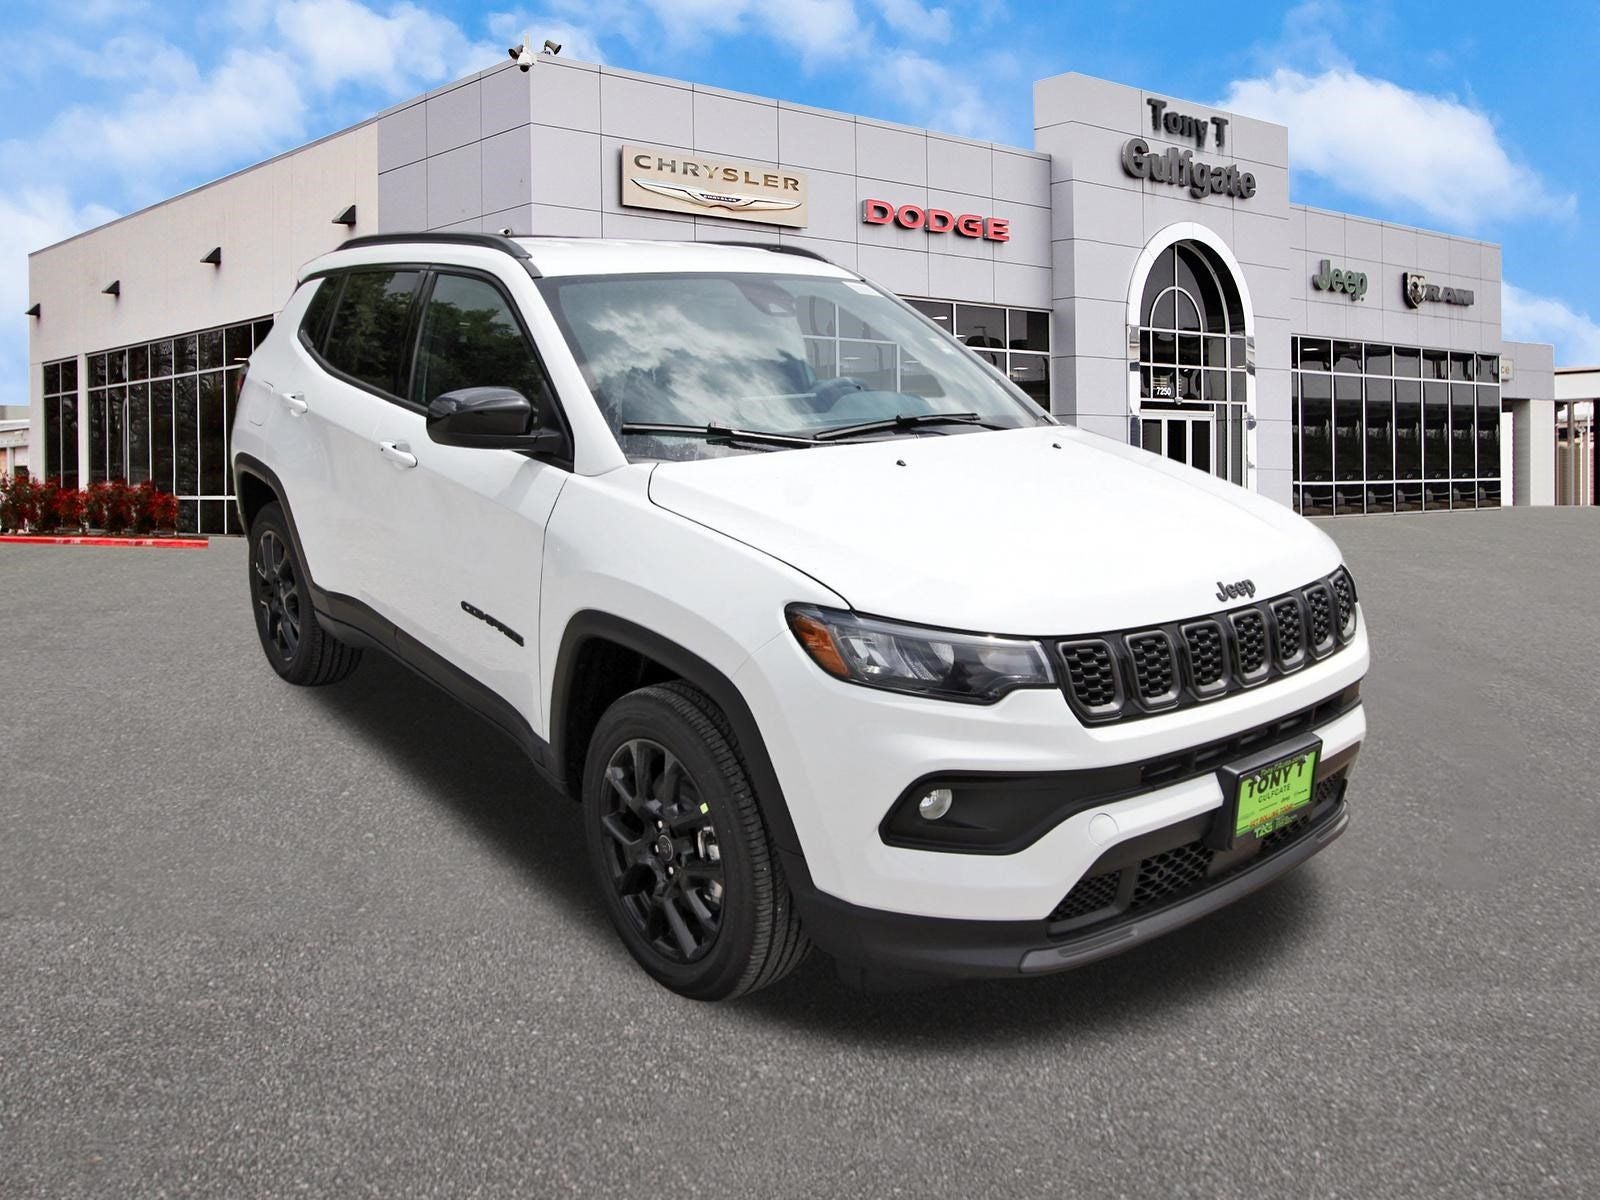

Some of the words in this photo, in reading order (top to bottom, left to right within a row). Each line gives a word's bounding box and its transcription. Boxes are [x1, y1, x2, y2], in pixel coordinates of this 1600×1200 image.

[1146, 98, 1208, 148] Tony
[1210, 116, 1229, 148] T
[633, 154, 800, 192] CHRYSLER
[1120, 138, 1257, 199] Gulfgate
[862, 198, 1010, 243] DODGE
[1312, 259, 1368, 301] Jeep
[1425, 283, 1475, 307] RAM
[1215, 579, 1256, 602] Jeep
[1247, 761, 1294, 799] TONY
